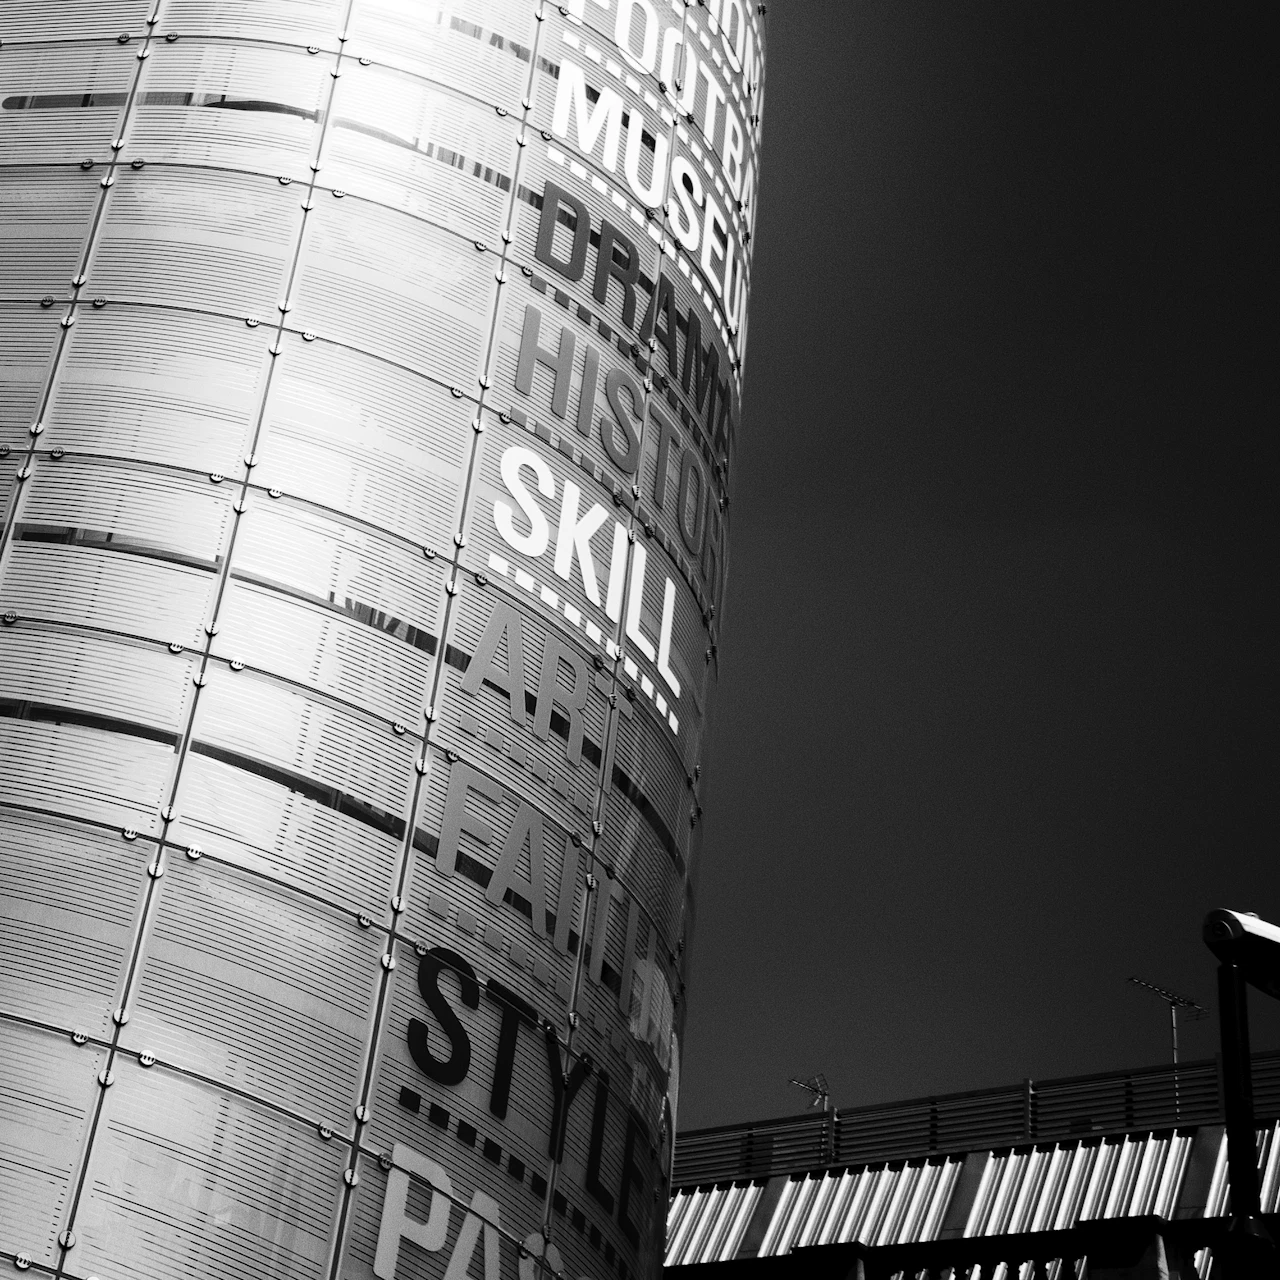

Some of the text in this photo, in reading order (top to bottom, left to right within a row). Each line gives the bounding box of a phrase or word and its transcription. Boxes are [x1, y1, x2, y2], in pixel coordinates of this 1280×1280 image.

[494, 446, 680, 698] SKILL
[515, 304, 721, 605] HISTOR
[460, 600, 632, 794] ART
[436, 764, 657, 1041] FAITH
[408, 947, 649, 1250] STYLE
